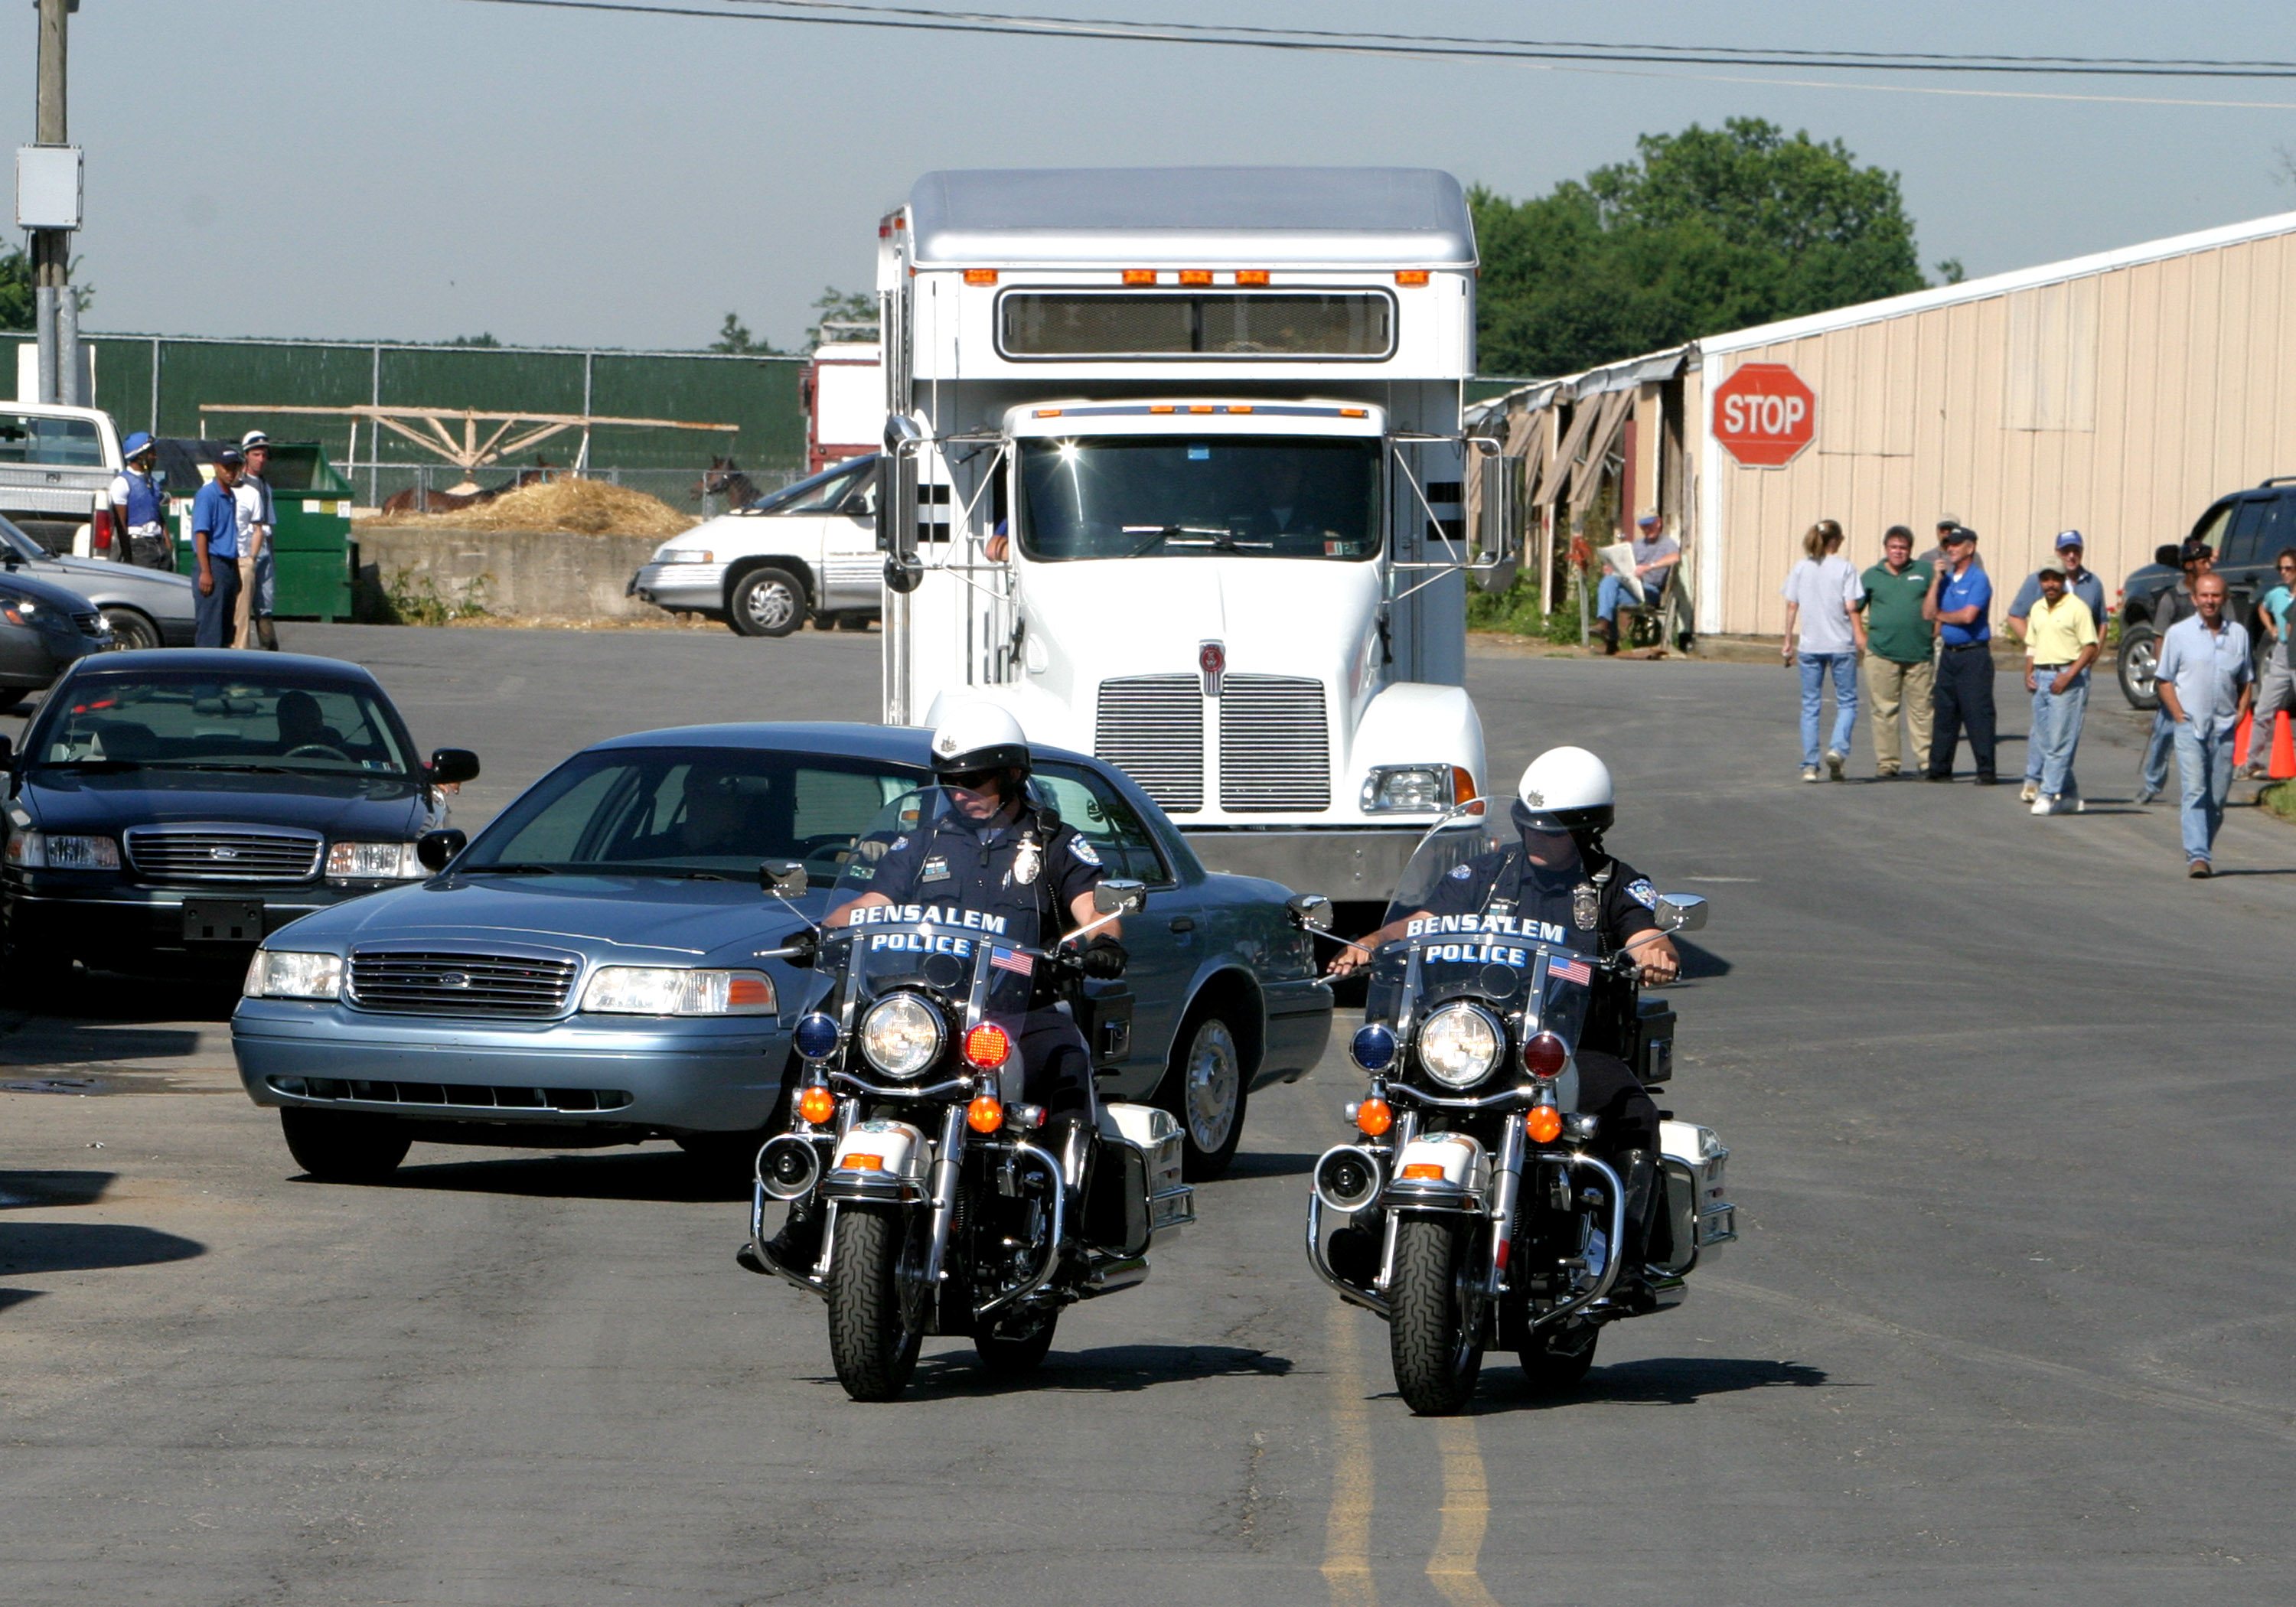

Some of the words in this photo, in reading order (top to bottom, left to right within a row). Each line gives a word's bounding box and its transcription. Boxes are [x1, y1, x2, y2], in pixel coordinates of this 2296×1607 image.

[1724, 393, 1805, 435] STOP
[849, 905, 1006, 935] BENSALEM
[1407, 914, 1567, 945] BENSALEM
[871, 934, 970, 957] POLICE
[1426, 944, 1526, 967] POLICE
